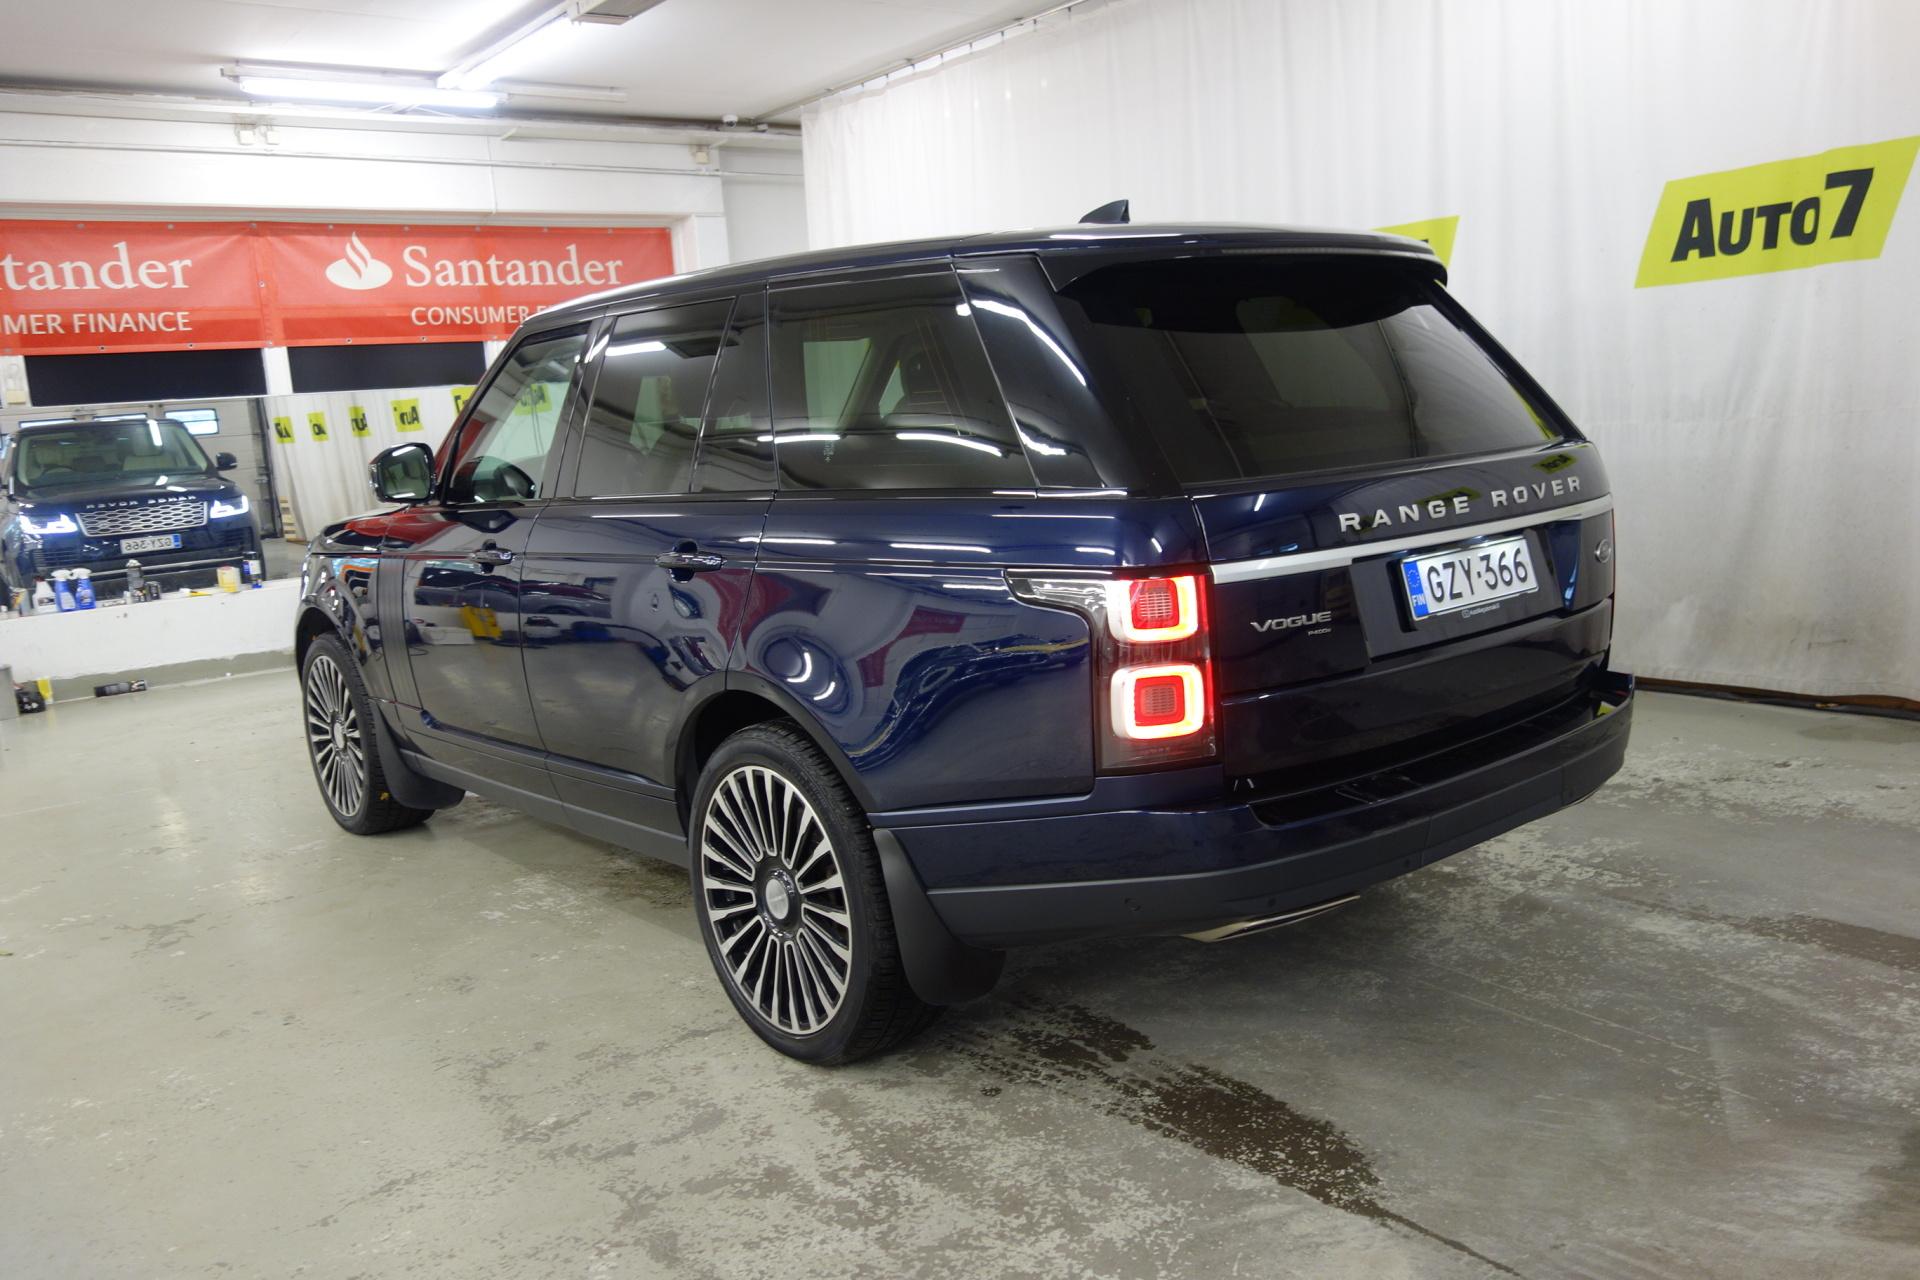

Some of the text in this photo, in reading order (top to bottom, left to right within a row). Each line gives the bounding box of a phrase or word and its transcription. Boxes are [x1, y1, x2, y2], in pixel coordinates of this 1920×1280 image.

[0, 241, 193, 291] tander
[402, 244, 623, 288] Santander
[73, 311, 193, 333] FINANCE
[411, 305, 529, 325] CONSUMER
[1338, 476, 1581, 533] RANGE ROVER
[1427, 547, 1528, 603] GZY-366
[1412, 593, 1426, 607] FIN
[1250, 611, 1332, 632] VOGUE
